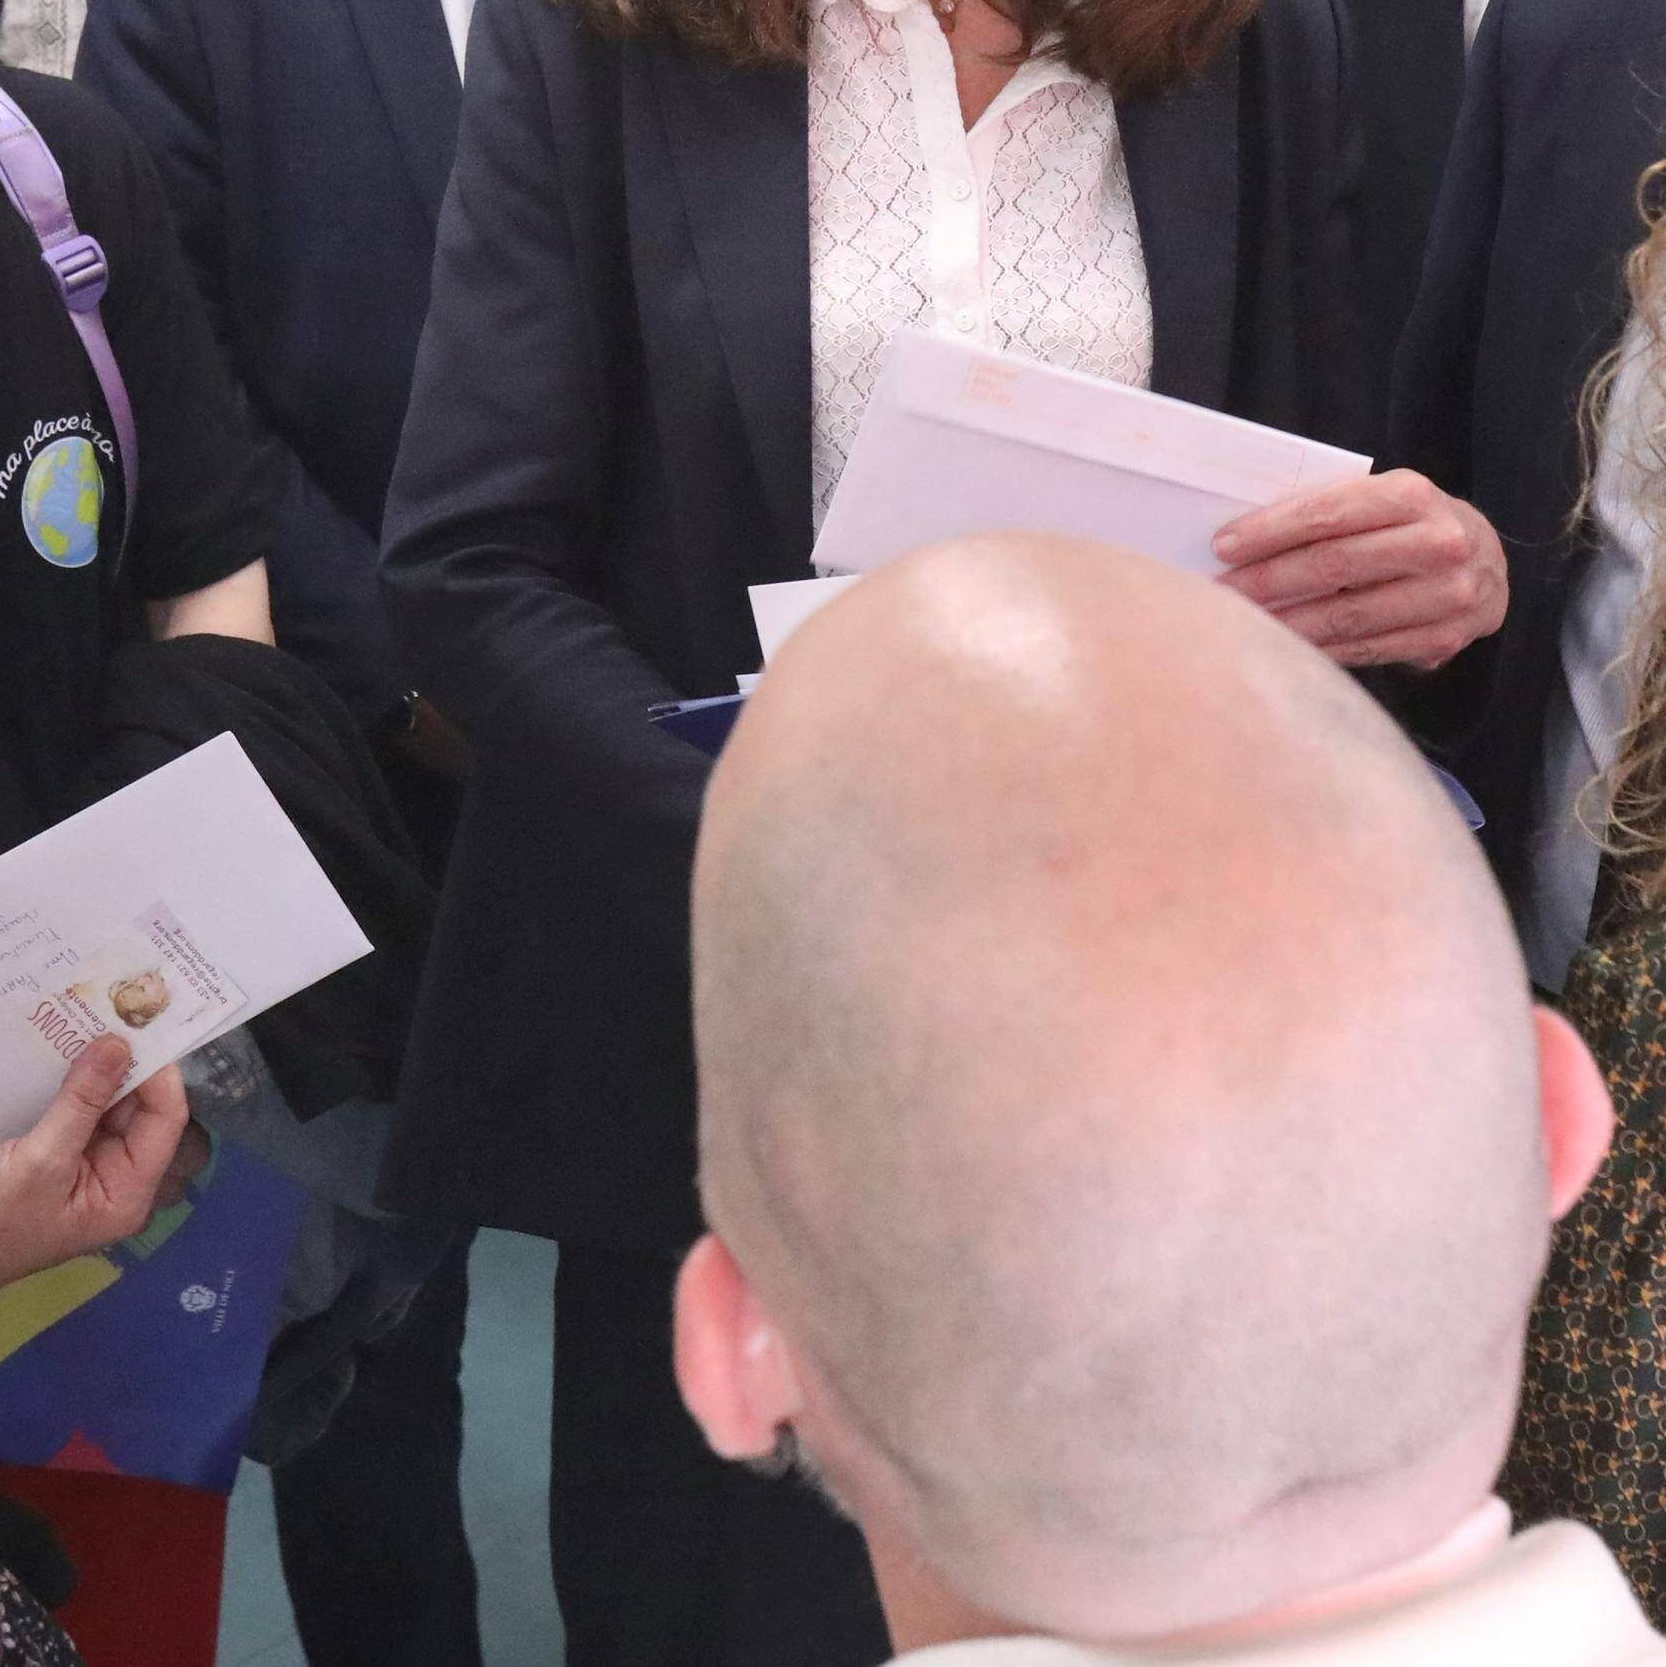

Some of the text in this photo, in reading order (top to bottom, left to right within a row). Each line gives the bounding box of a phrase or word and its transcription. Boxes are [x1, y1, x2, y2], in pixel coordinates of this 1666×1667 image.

[23, 415, 80, 460] place
[81, 412, 93, 431] à
[27, 998, 86, 1060] DDONS
[65, 986, 105, 1033] Clemente
